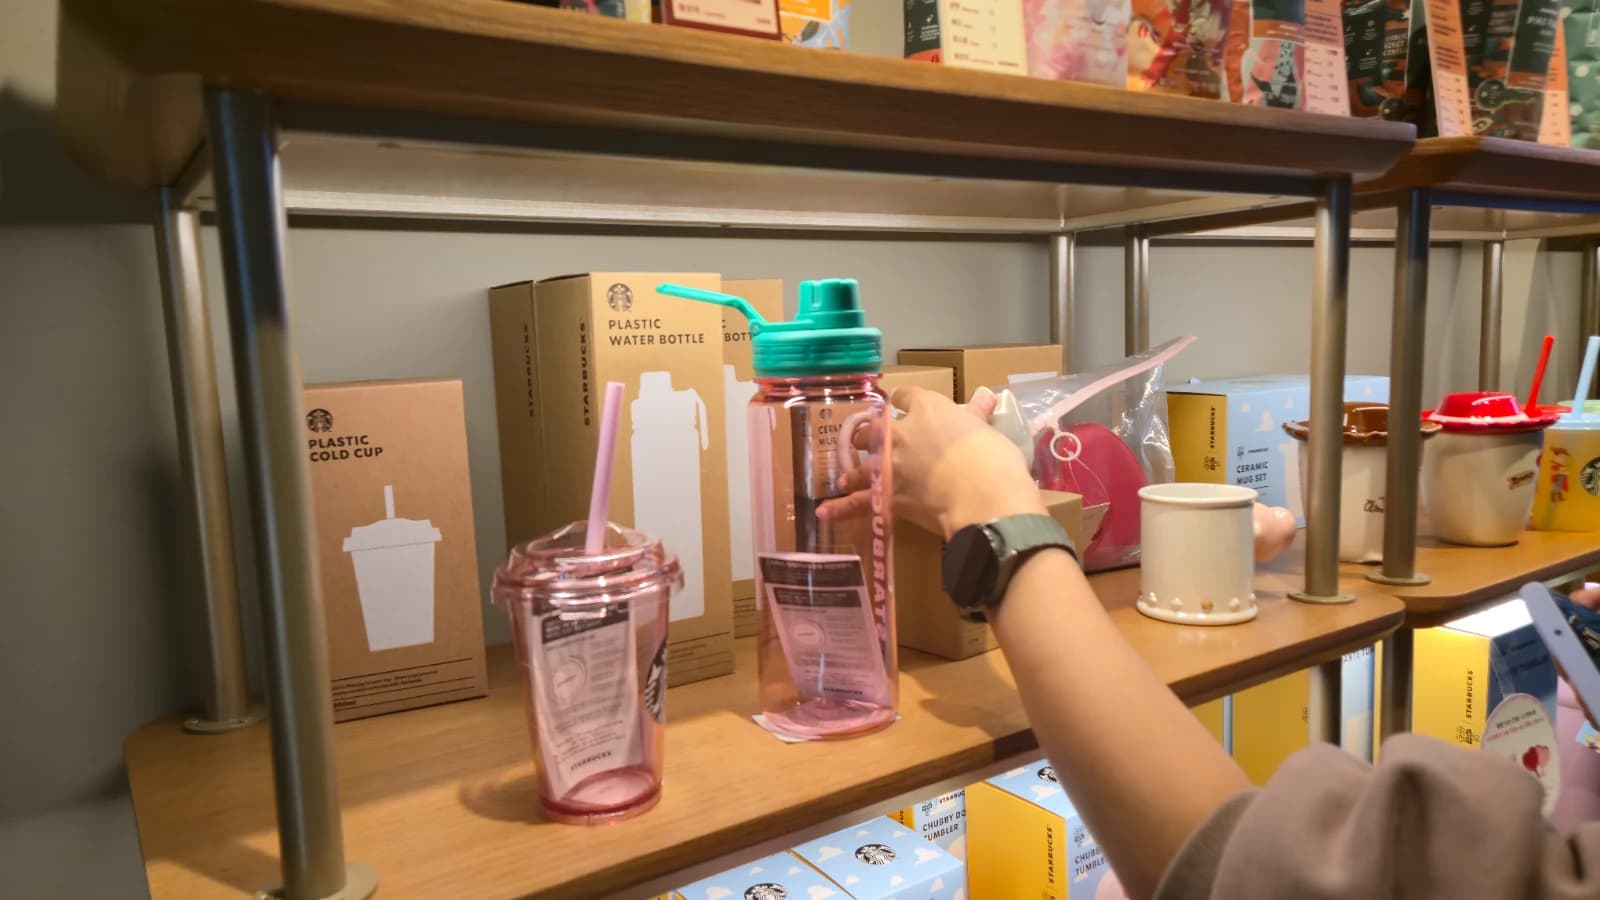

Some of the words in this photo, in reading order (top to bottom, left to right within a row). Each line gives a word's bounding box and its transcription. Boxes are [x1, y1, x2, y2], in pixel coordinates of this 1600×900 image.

[608, 318, 662, 330] PLASTIC
[609, 335, 655, 346] WATER
[659, 333, 705, 345] BOTTLE
[580, 321, 591, 427] STARBUCKS
[308, 434, 369, 449] PLASTIC
[310, 449, 350, 462] COLD
[354, 447, 383, 458] CUP
[1236, 461, 1269, 474] CERAMIC
[1236, 475, 1254, 485] MUG
[1255, 472, 1267, 483] SET
[1465, 669, 1474, 719] STARBUCKS
[922, 813, 954, 832] CHUBBY
[1046, 824, 1055, 885] STARBUCKS
